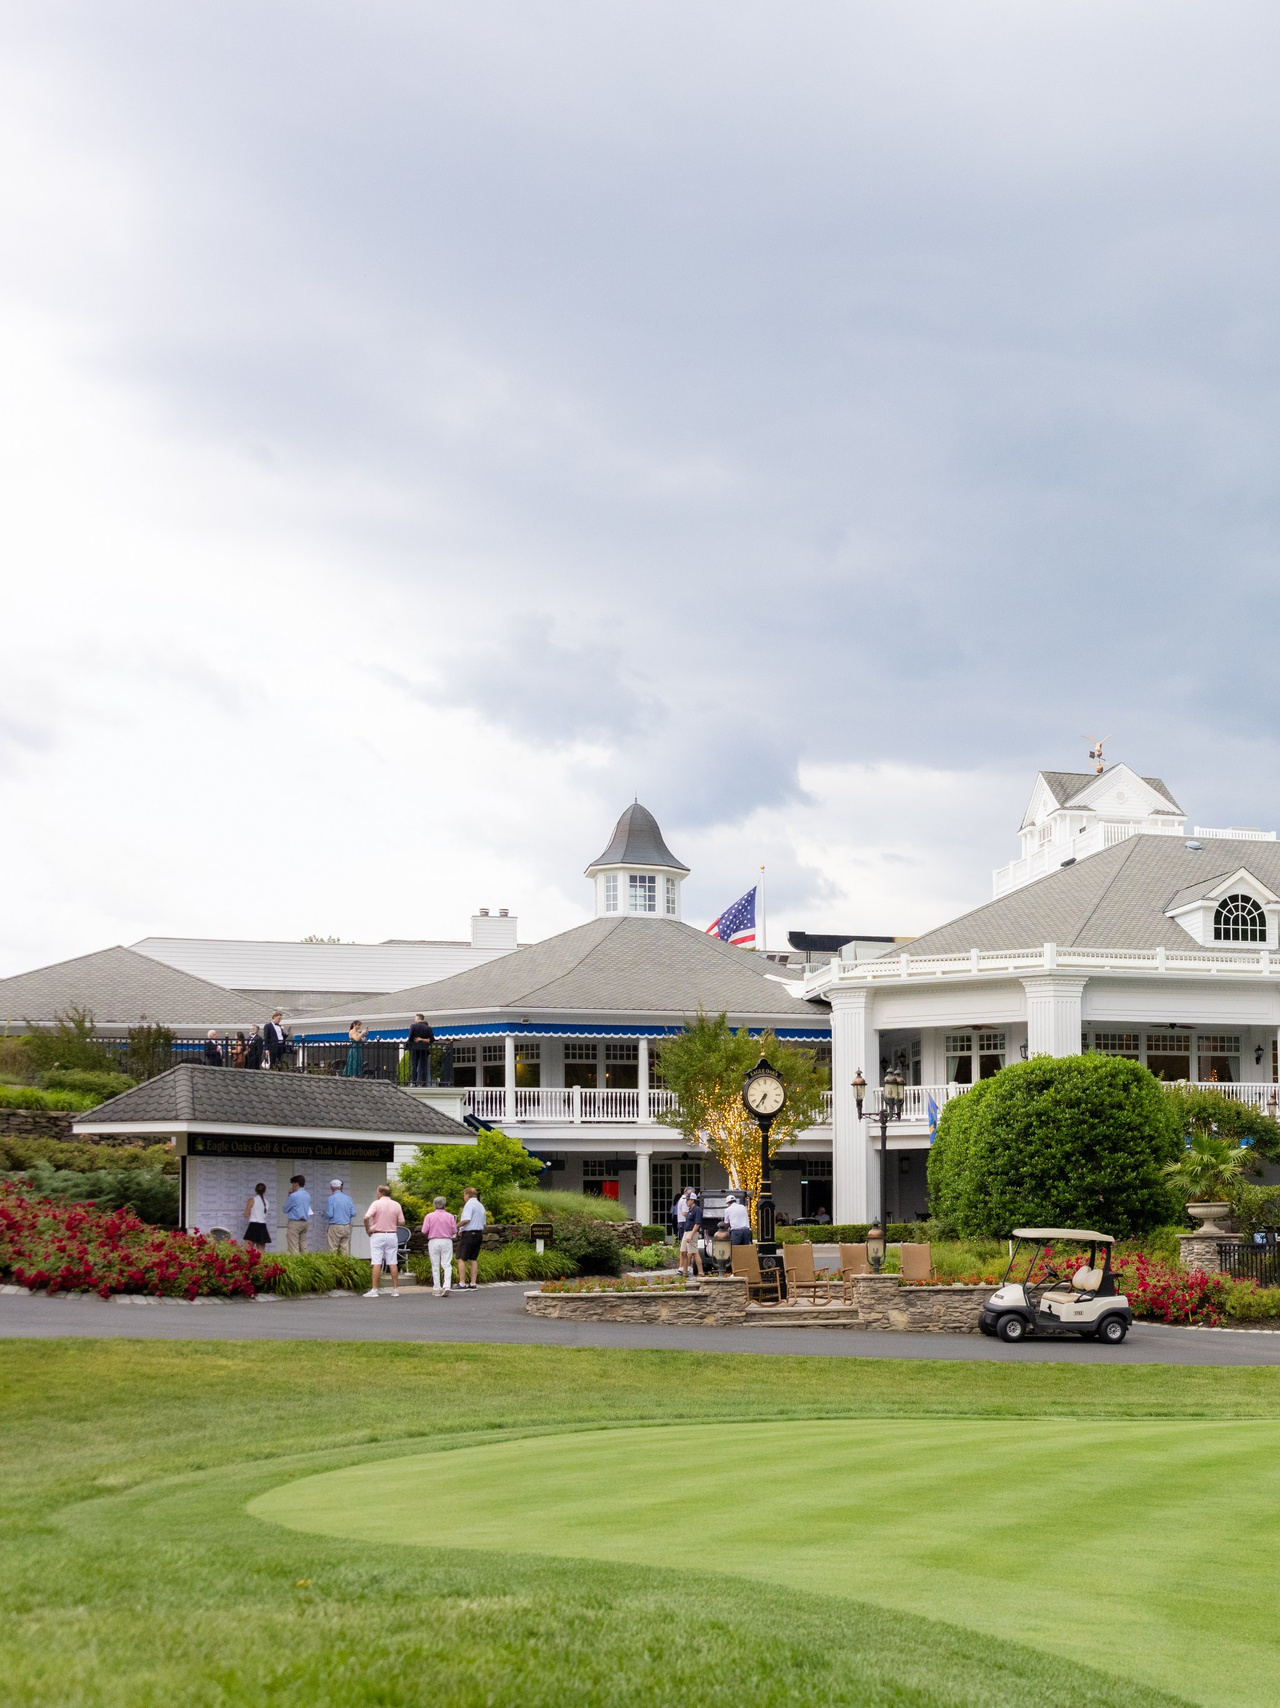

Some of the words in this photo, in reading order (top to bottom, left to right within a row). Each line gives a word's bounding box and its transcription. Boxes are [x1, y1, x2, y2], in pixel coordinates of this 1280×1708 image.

[206, 1140, 229, 1153] Eagle
[231, 1141, 252, 1152] Oaks
[253, 1142, 271, 1153] Golf
[273, 1143, 280, 1153] &
[281, 1143, 313, 1157] Country
[315, 1144, 333, 1155] Club
[334, 1146, 380, 1157] Leaderboard
